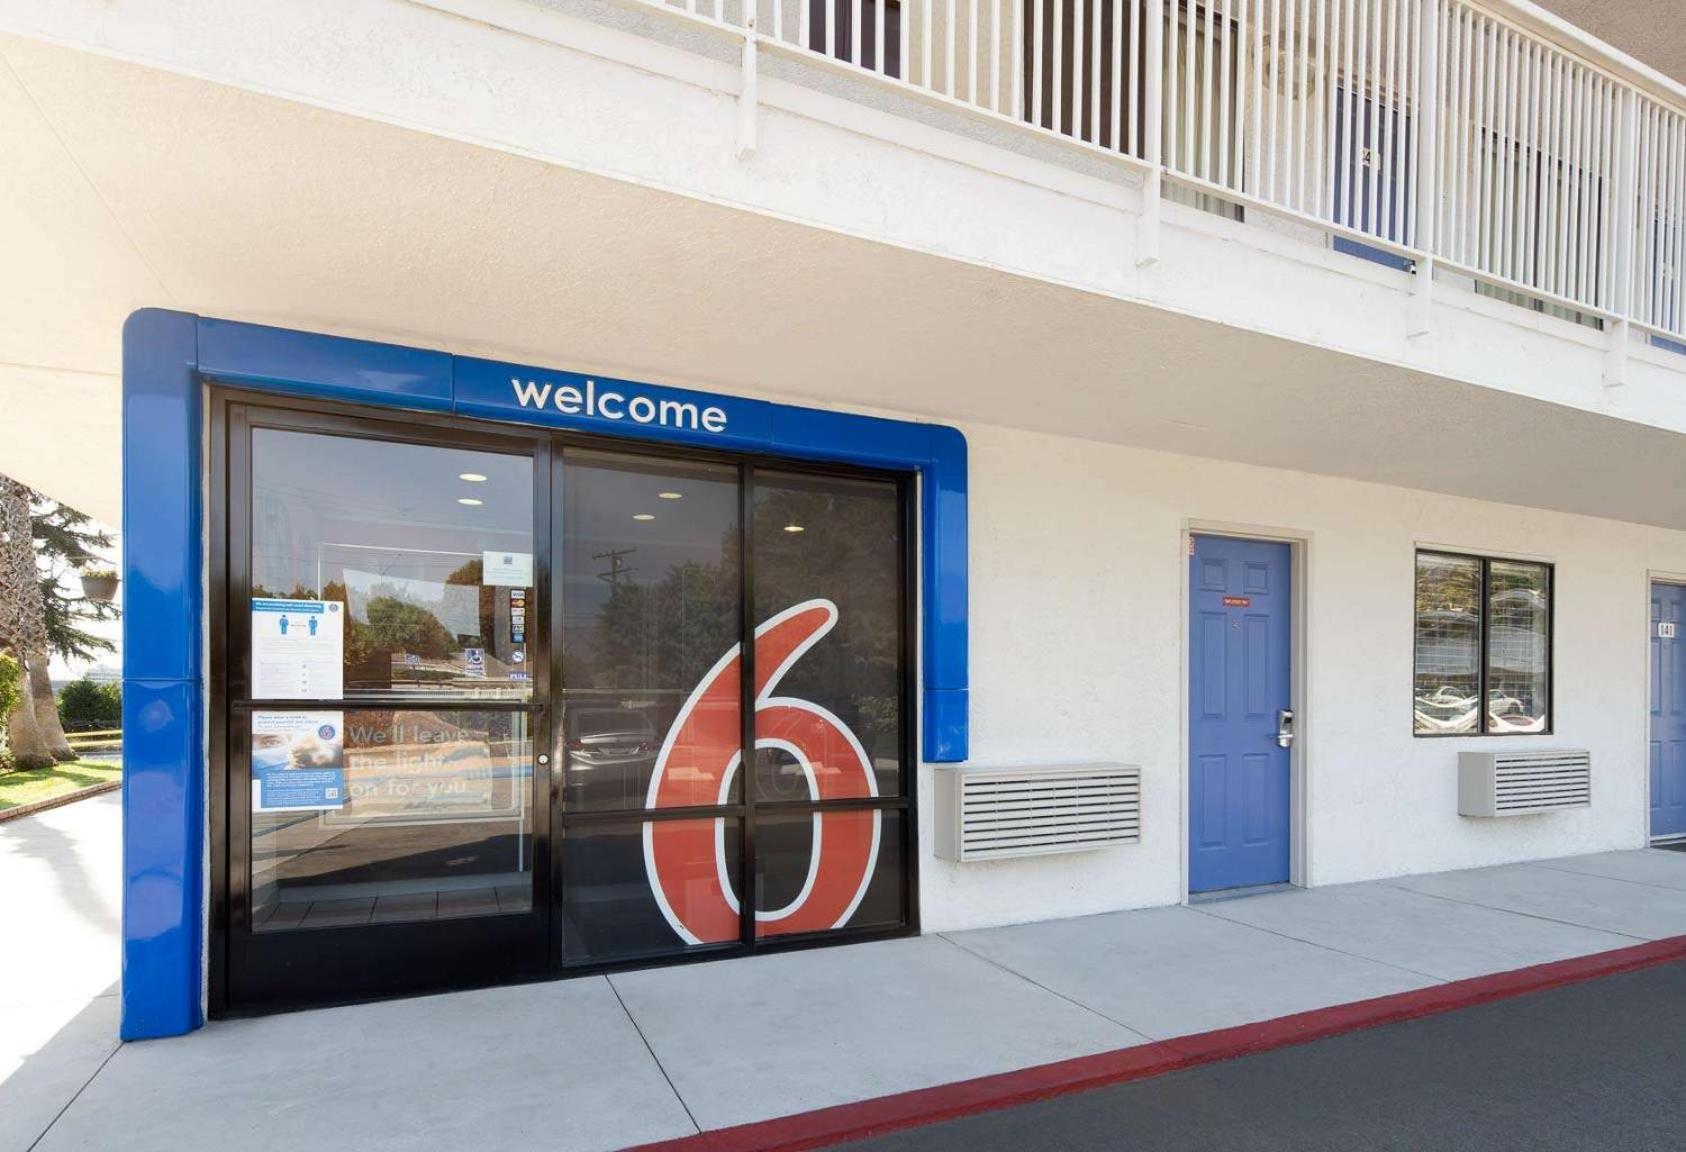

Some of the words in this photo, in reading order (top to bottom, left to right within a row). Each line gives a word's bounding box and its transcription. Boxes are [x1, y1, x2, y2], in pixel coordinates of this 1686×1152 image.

[511, 379, 727, 433] welcome
[413, 725, 469, 742] leave
[396, 749, 446, 773] light
[642, 598, 882, 945] 6
[349, 783, 378, 797] on
[387, 779, 418, 795] for
[427, 781, 466, 800] you
